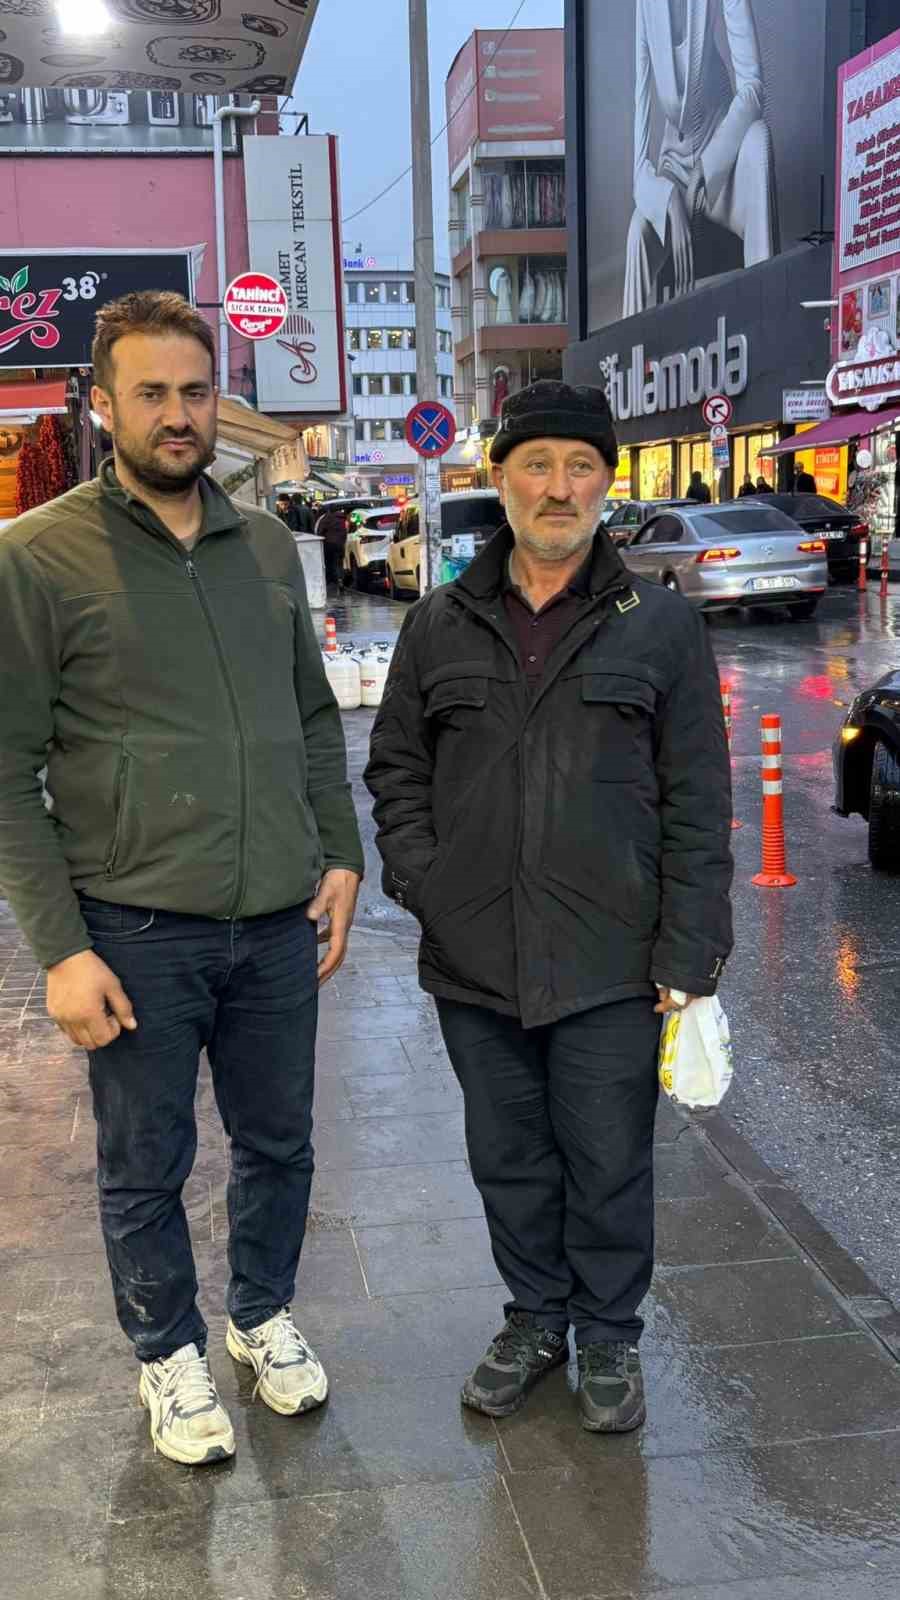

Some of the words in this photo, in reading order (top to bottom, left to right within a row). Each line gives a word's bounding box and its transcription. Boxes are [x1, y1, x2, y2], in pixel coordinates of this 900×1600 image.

[288, 163, 304, 232] TEKSTİL
[62, 276, 97, 301] 38
[231, 286, 280, 303] TAHİNCİ
[278, 250, 292, 308] HMET
[294, 240, 308, 309] MERCAN
[231, 303, 255, 312] SICAK
